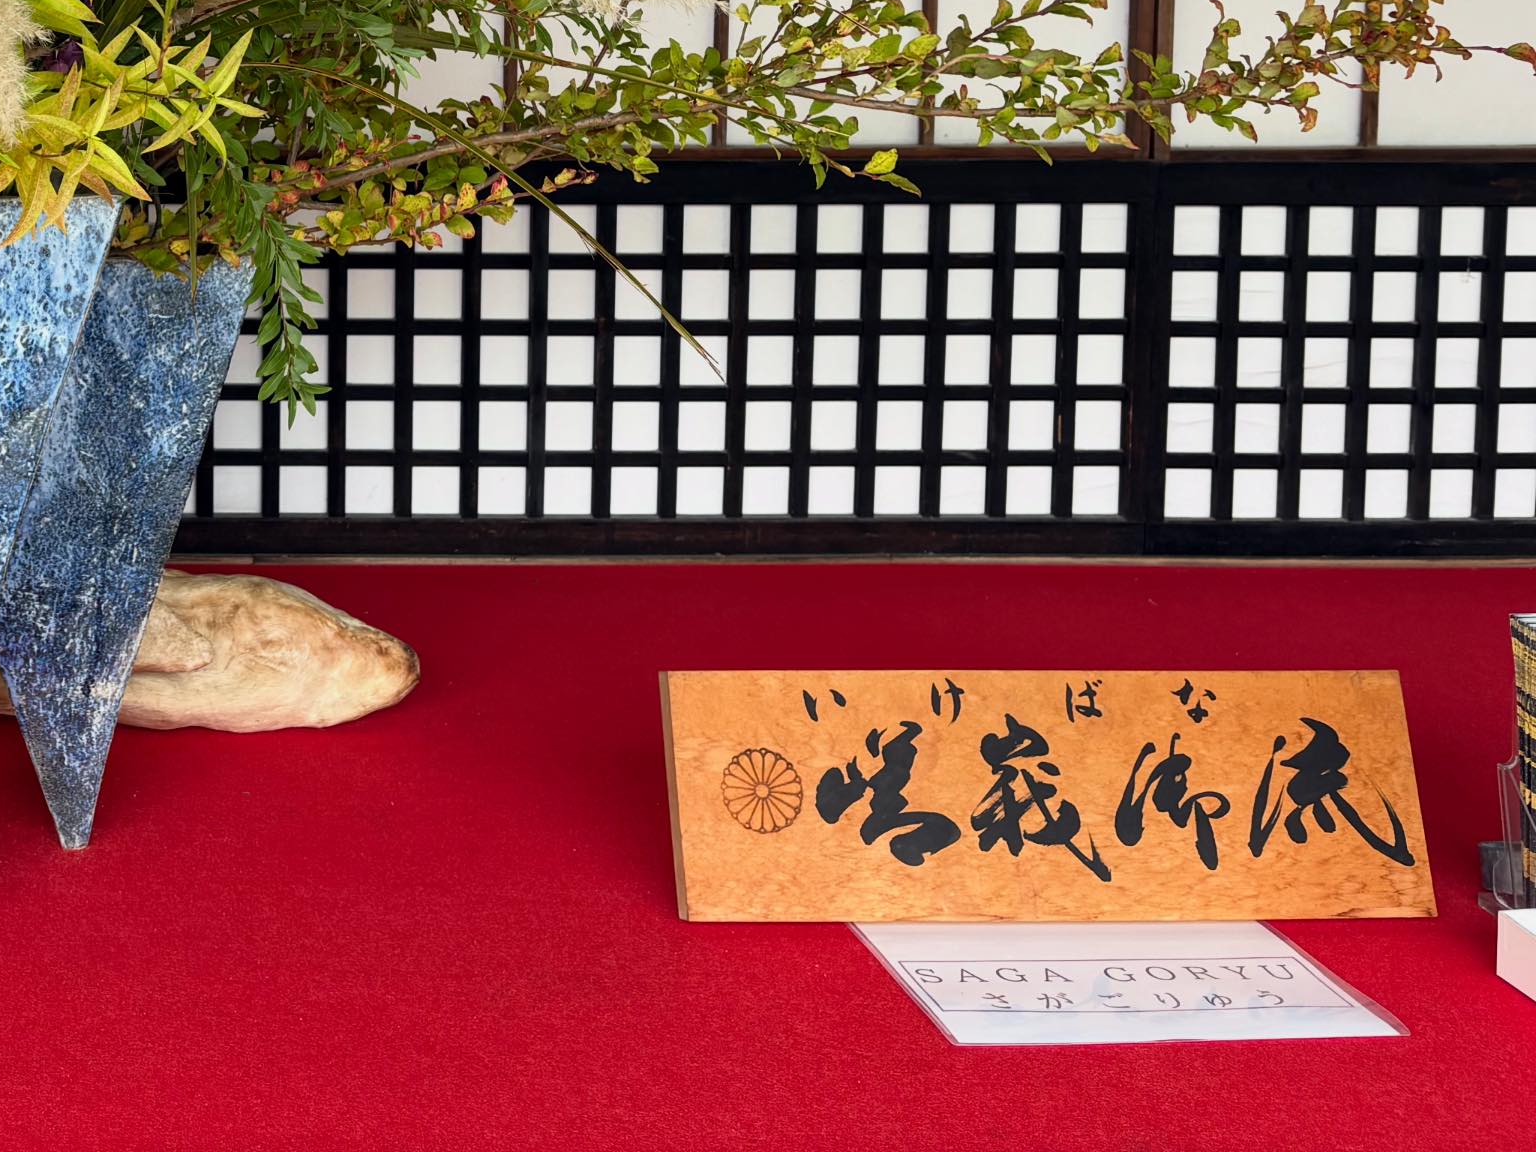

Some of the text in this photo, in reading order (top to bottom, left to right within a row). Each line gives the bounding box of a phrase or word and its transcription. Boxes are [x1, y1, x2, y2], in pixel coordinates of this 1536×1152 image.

[802, 678, 1217, 724] いけばな
[915, 963, 1296, 984] SAGA GORYU
